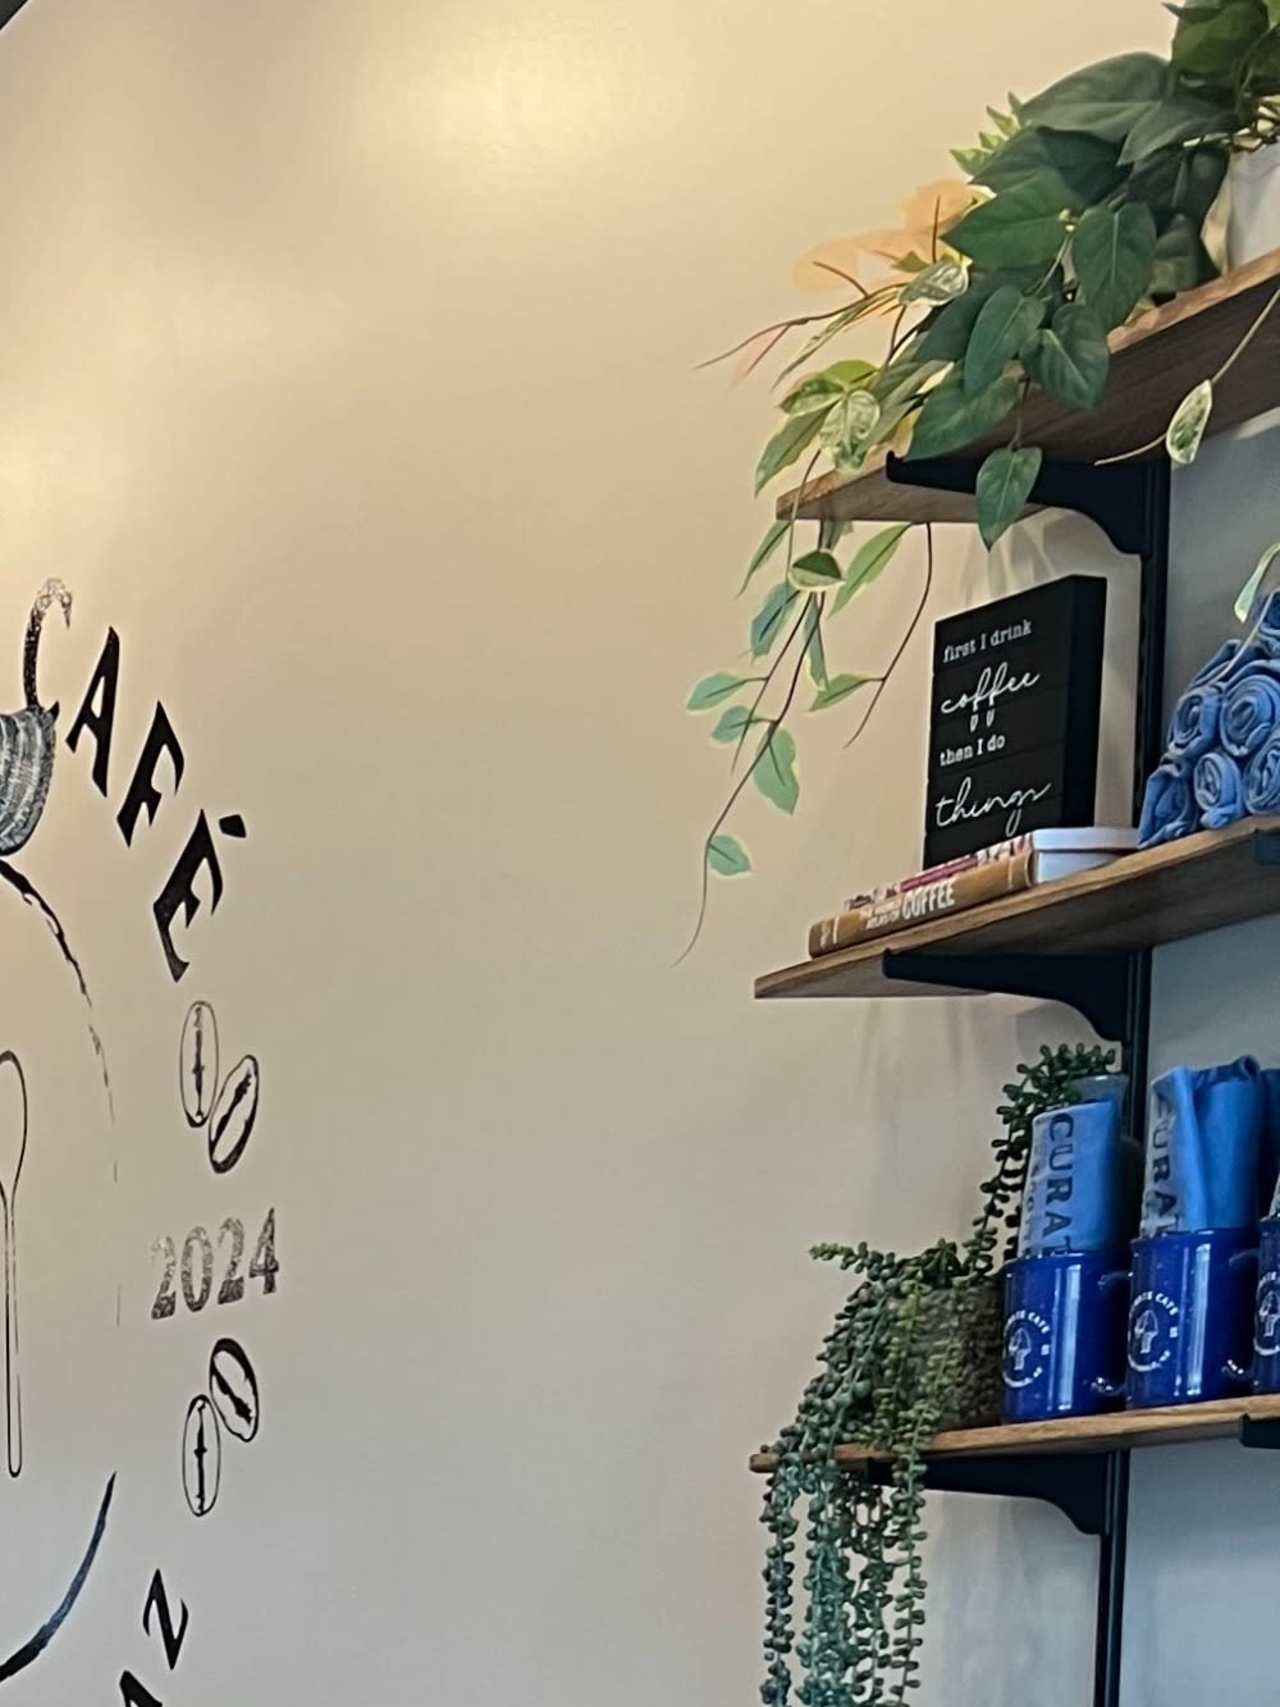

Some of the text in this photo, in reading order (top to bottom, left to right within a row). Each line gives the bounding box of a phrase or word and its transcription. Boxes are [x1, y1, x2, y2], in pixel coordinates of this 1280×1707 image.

[943, 618, 1032, 664] first I drink
[940, 661, 1040, 732] coffee
[940, 733, 1006, 767] then I do
[935, 776, 1052, 838] things
[1042, 1112, 1074, 1256] CURAT
[151, 1207, 280, 1320] 2024
